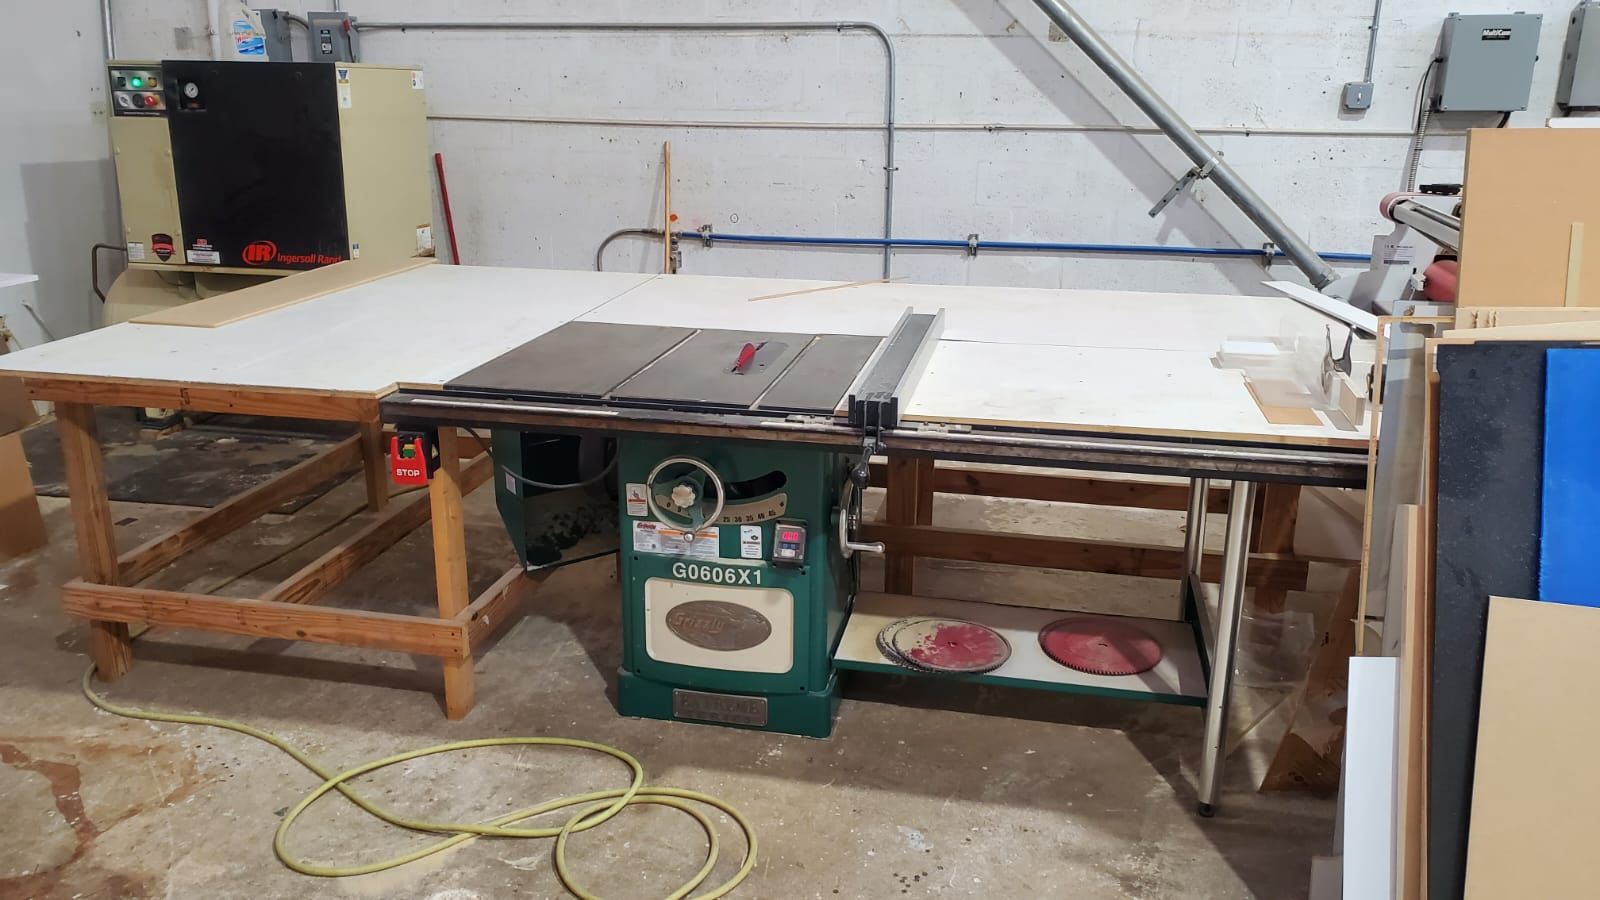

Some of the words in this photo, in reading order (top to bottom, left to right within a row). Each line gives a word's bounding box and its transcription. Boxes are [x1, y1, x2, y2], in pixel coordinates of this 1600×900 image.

[246, 244, 273, 261] IR
[277, 253, 316, 264] Ingersoll
[396, 468, 420, 477] STOP
[672, 562, 761, 585] G0606X1
